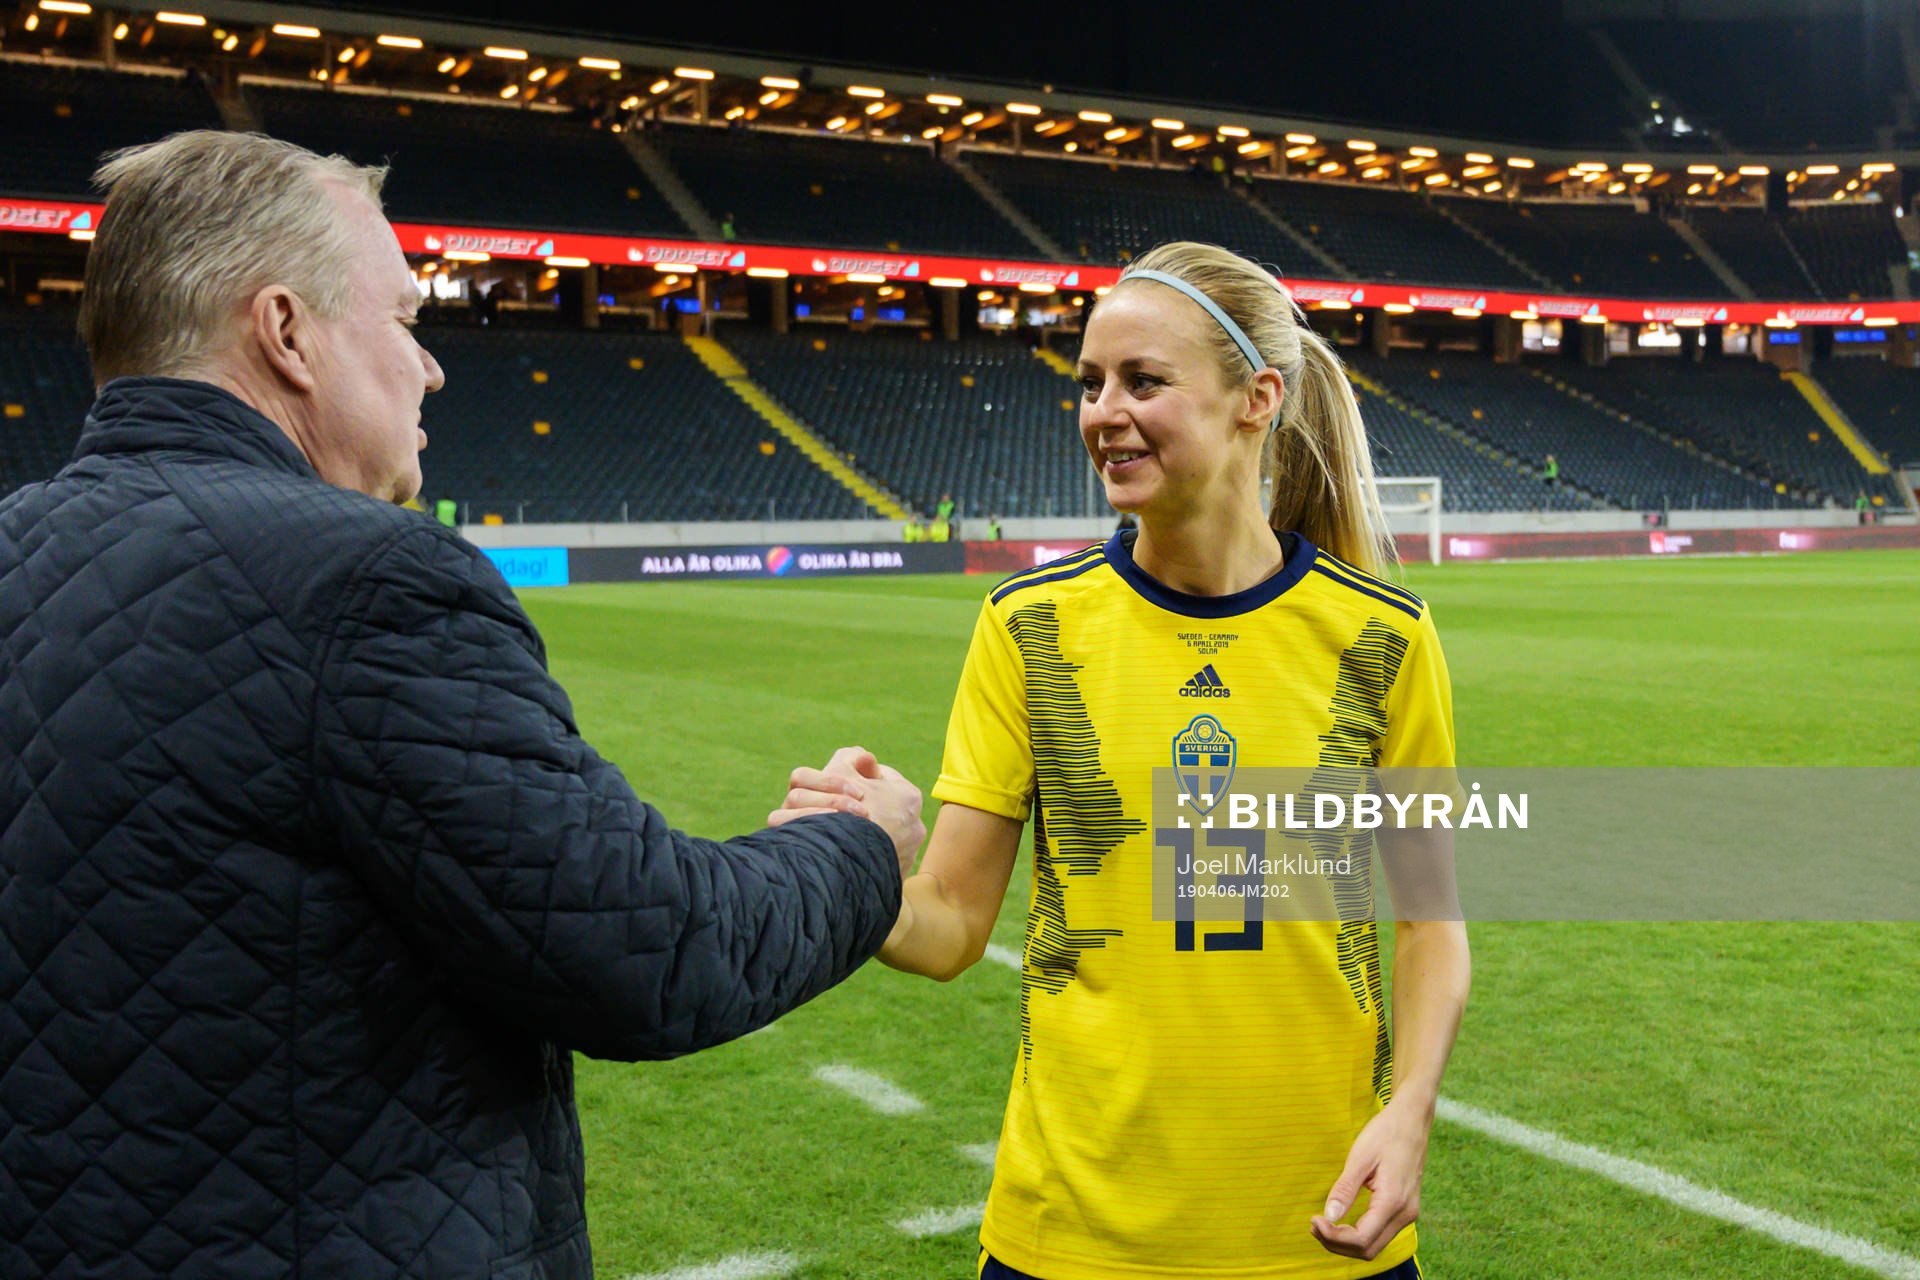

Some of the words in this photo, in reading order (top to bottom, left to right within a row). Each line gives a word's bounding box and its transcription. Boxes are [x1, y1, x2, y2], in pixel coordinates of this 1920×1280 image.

[444, 234, 539, 255] ODDSET
[646, 247, 731, 266] ODDSET
[828, 257, 907, 276] ODDSET
[641, 556, 686, 573] ALLA
[687, 553, 711, 572] ÄR
[711, 554, 762, 572] OLIKA
[799, 553, 847, 570] OLIKA
[848, 550, 870, 569] ÄR
[871, 552, 903, 568] BRA
[1177, 632, 1203, 640] SWEDEN
[1209, 633, 1239, 641] GERMANY
[1213, 640, 1229, 648] 2019
[1198, 647, 1218, 655] SOLNA
[1178, 686, 1231, 698] adidas
[1185, 744, 1225, 752] SVERIGE
[1155, 828, 1266, 951] 13
